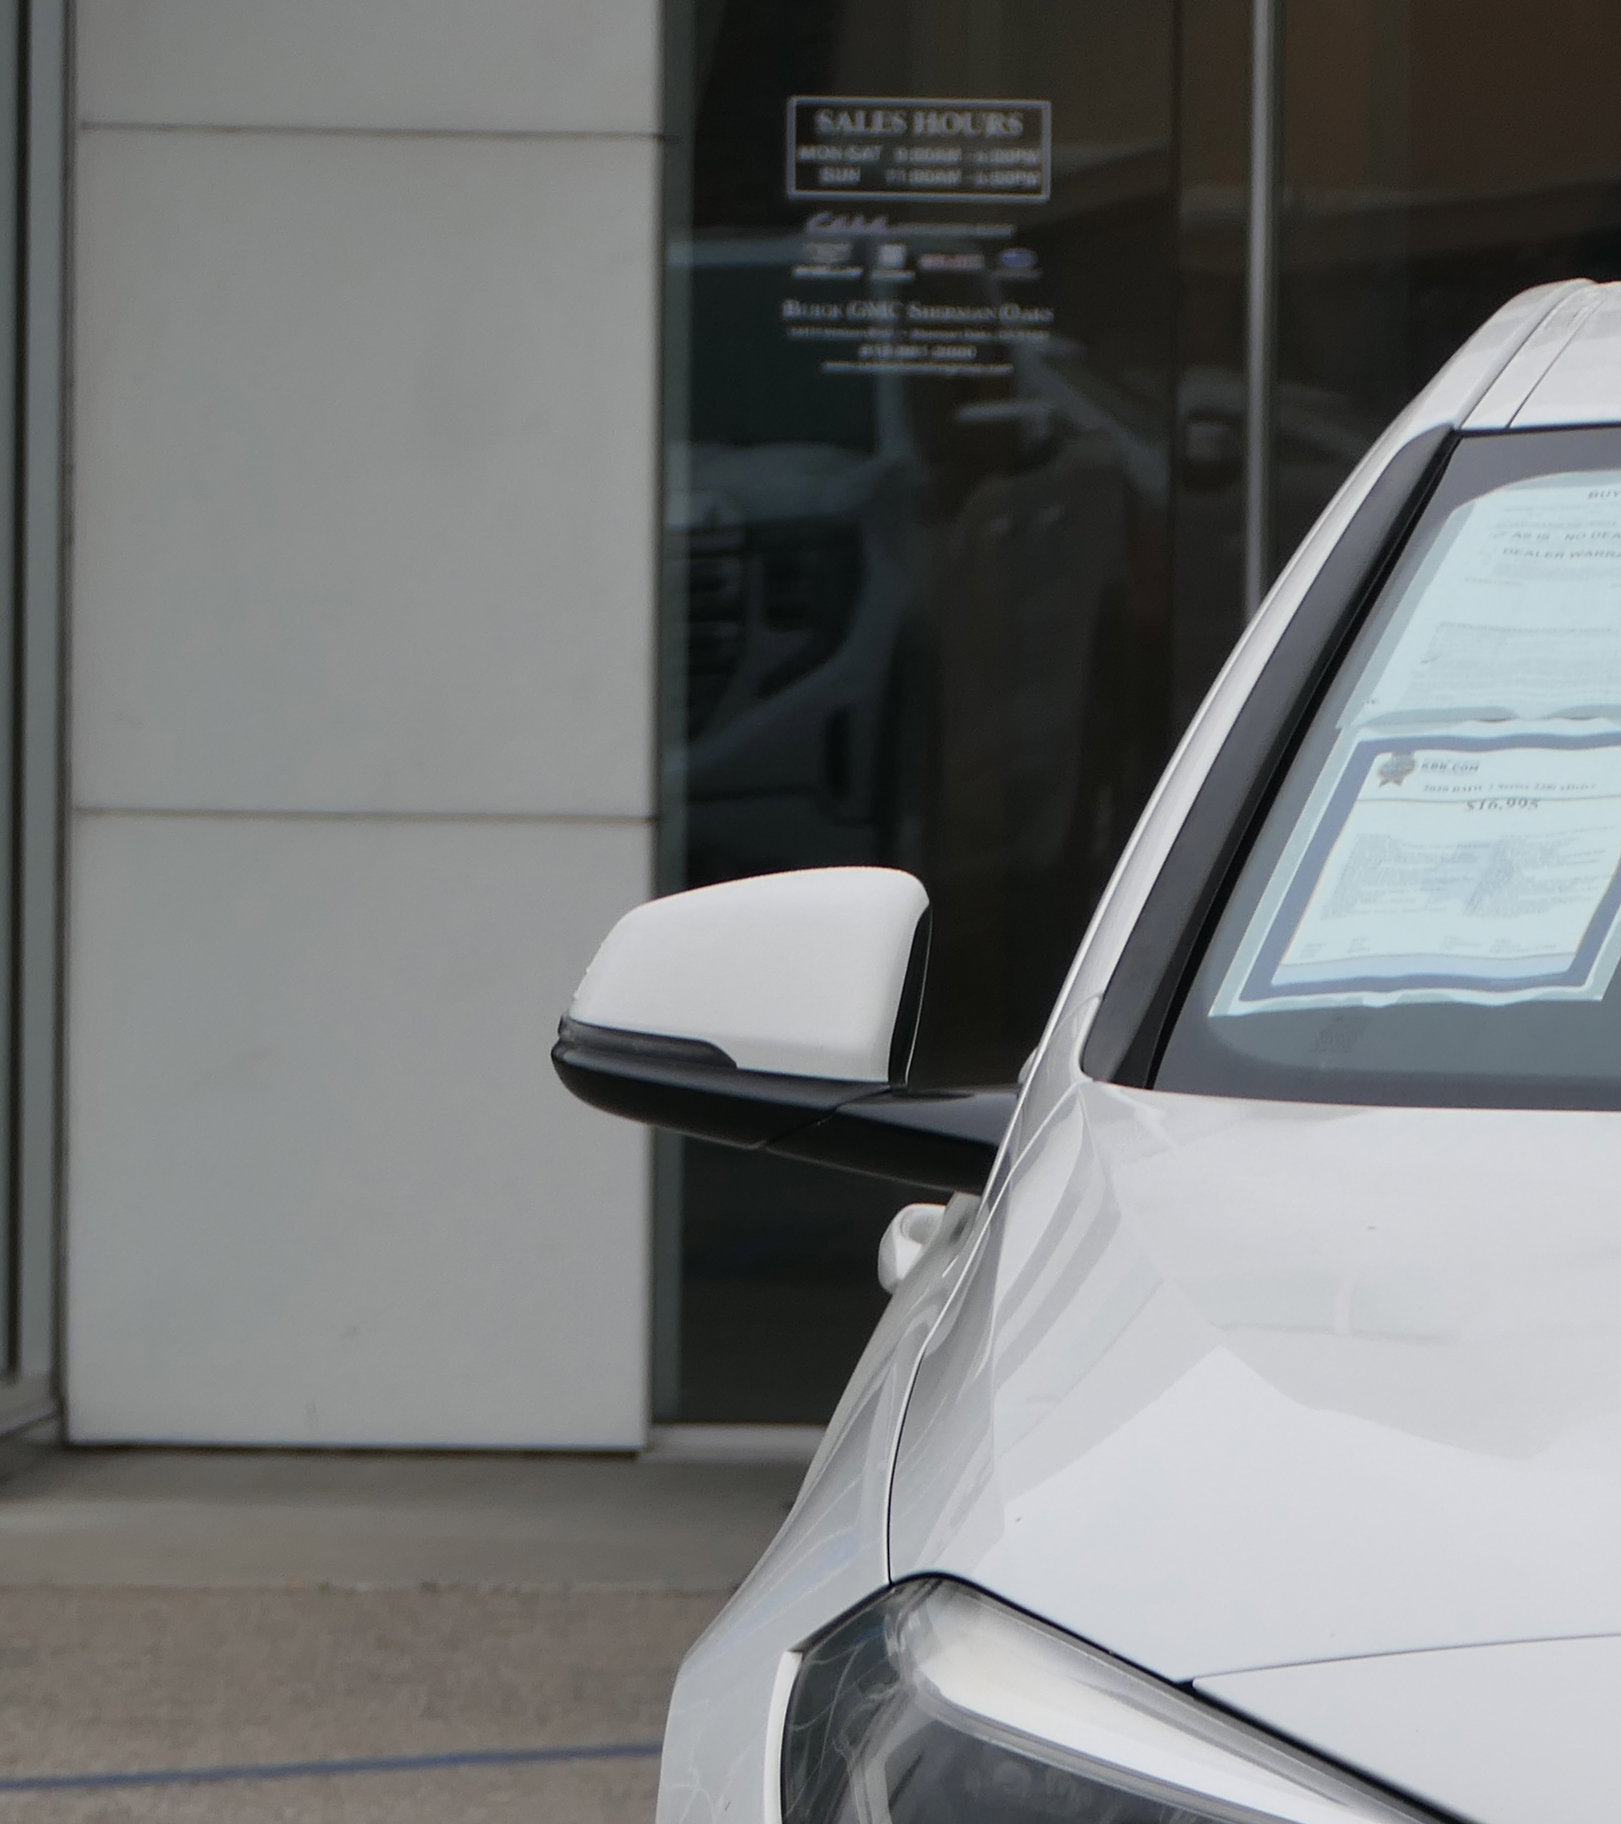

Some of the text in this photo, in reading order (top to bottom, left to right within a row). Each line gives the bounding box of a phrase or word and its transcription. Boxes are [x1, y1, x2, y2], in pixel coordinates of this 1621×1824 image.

[815, 110, 1024, 137] SALES HOURS
[1511, 531, 1532, 540] AS
[1564, 532, 1588, 542] NO
[1503, 547, 1564, 559] DEALER
